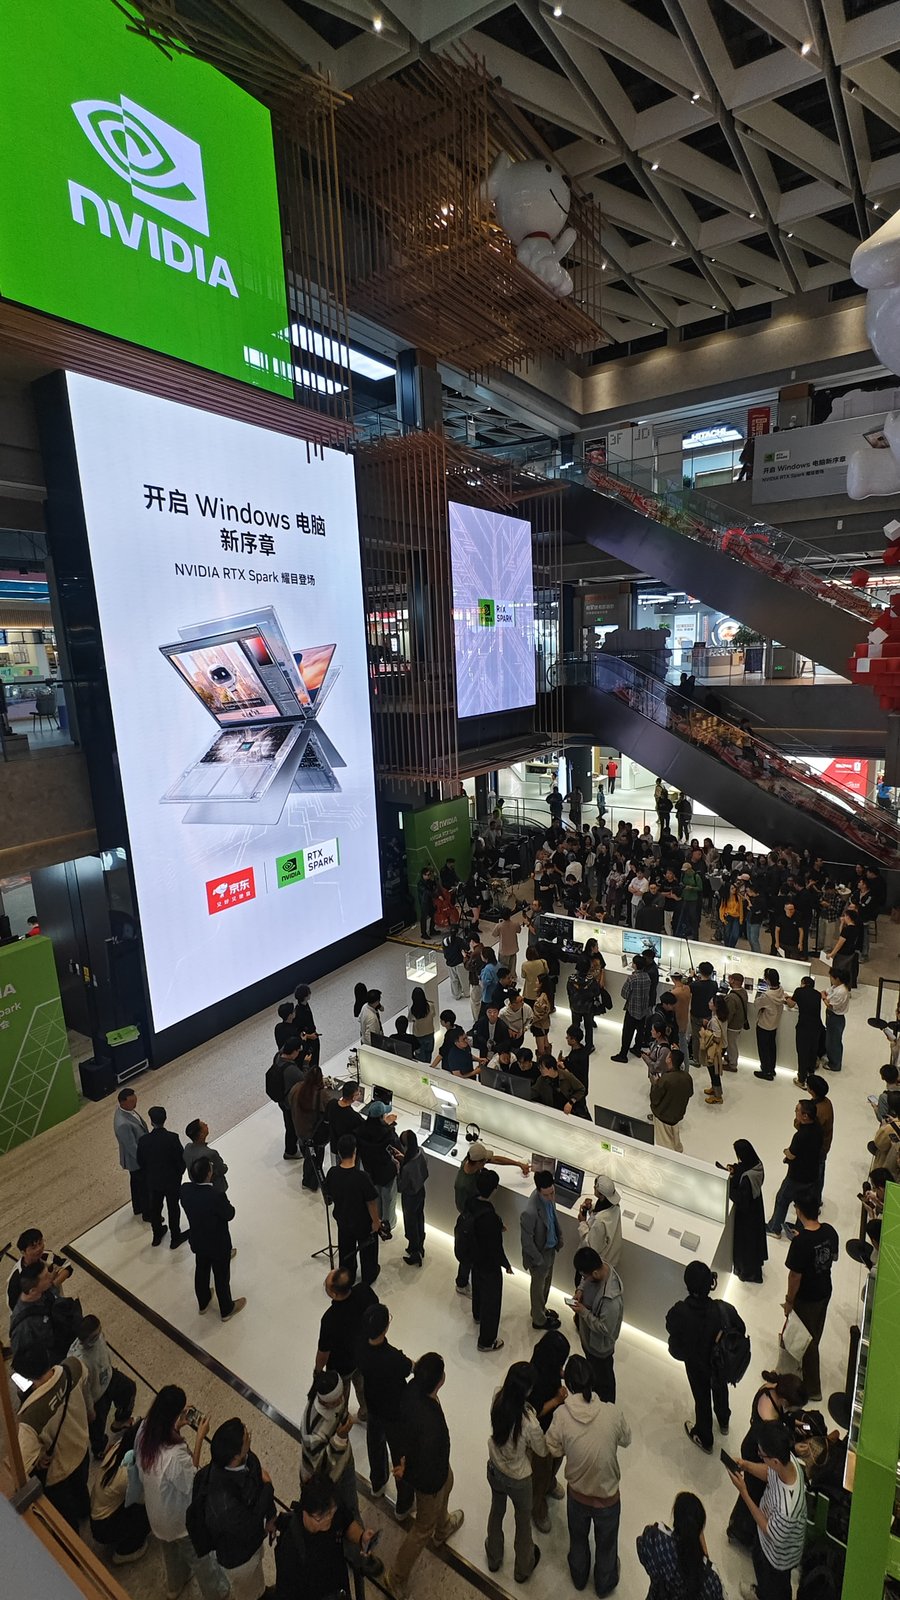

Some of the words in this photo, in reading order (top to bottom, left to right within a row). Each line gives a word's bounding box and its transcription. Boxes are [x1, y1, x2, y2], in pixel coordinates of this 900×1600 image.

[67, 179, 239, 299] NVIDIA
[610, 432, 623, 446] 3F
[634, 427, 650, 441] JD
[691, 427, 727, 440] HITACHI
[777, 462, 811, 472] Windows
[143, 484, 189, 516] 开启
[195, 493, 291, 530] Windows
[295, 512, 326, 537] 电脑
[219, 528, 276, 557] 新序章
[174, 563, 219, 579] NVIDIA
[223, 567, 247, 581] RTX
[248, 569, 280, 584] Spark
[281, 572, 316, 586] 耀目登场
[496, 614, 513, 623] SPARK
[307, 848, 323, 861] RTX
[308, 855, 335, 872] SPARK
[281, 871, 301, 882] NVIDIA
[229, 878, 251, 895] 京东
